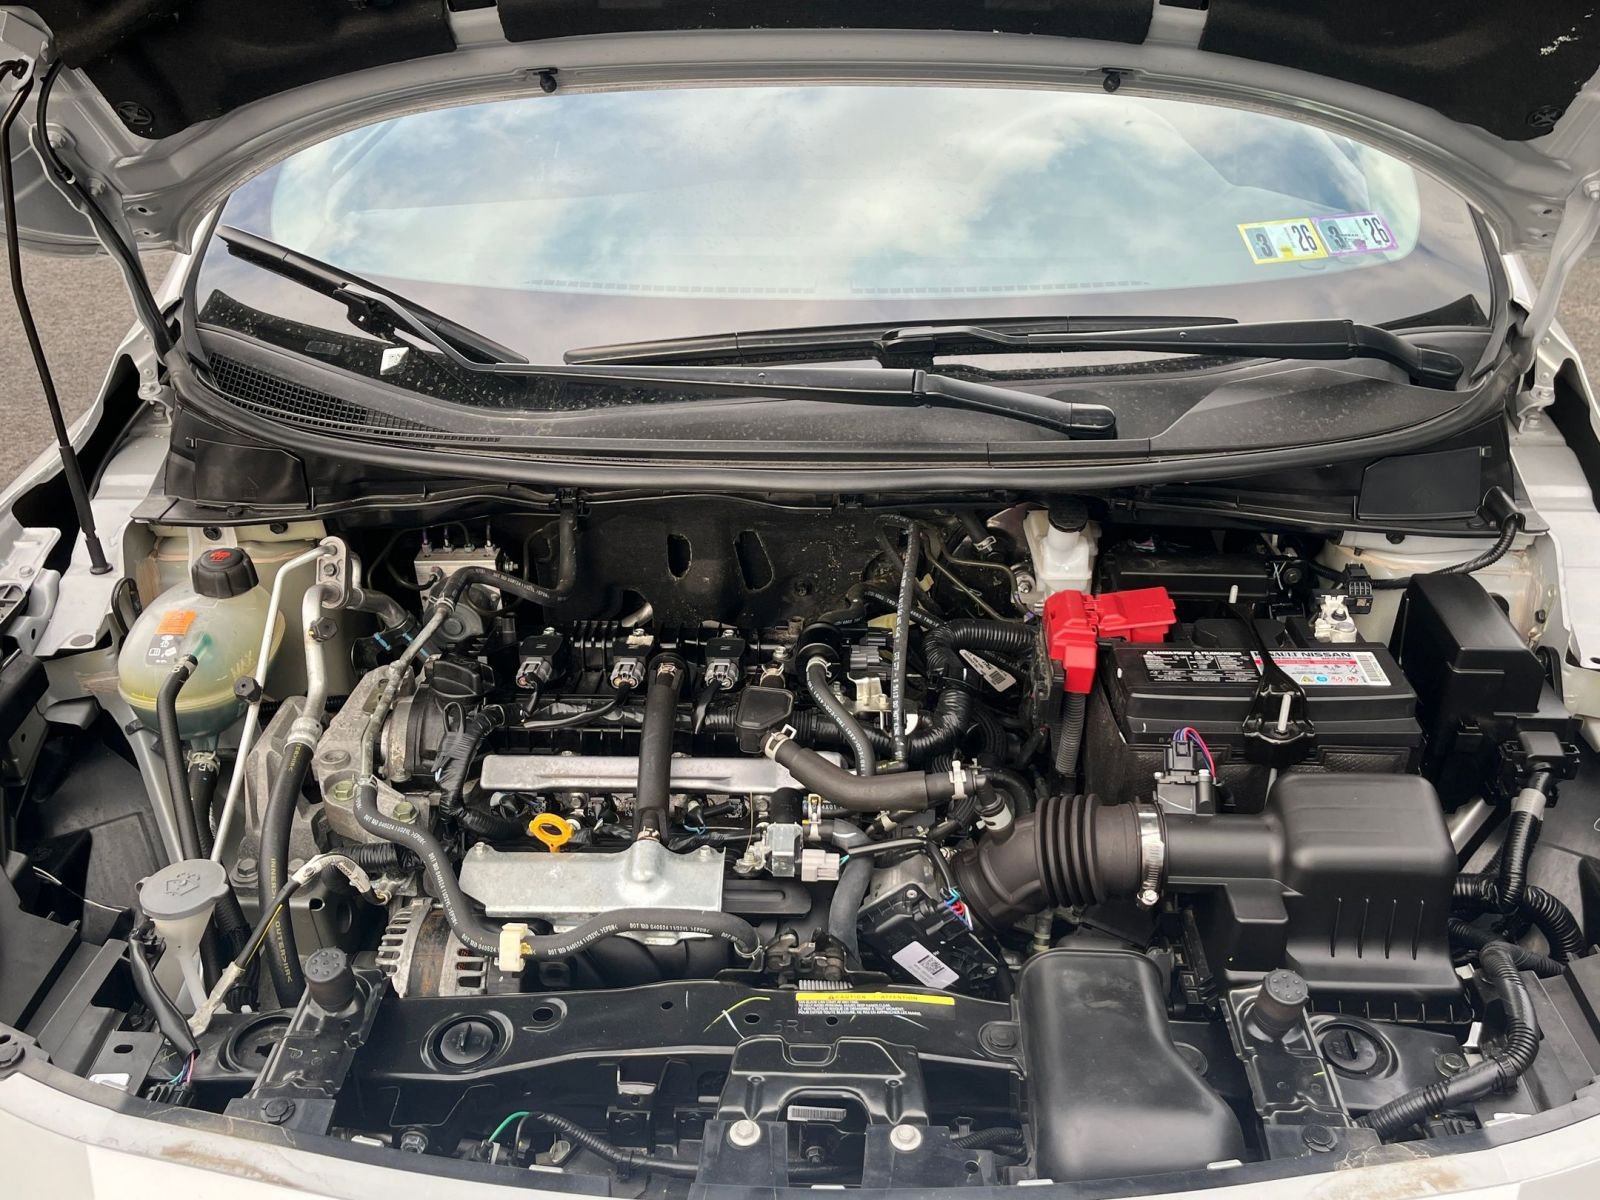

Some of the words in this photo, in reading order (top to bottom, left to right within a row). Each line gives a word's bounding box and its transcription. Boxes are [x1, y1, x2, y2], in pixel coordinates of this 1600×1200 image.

[1256, 233, 1272, 257] 3
[1292, 224, 1318, 252] 26
[1328, 226, 1346, 249] 3
[1363, 217, 1390, 245] 26
